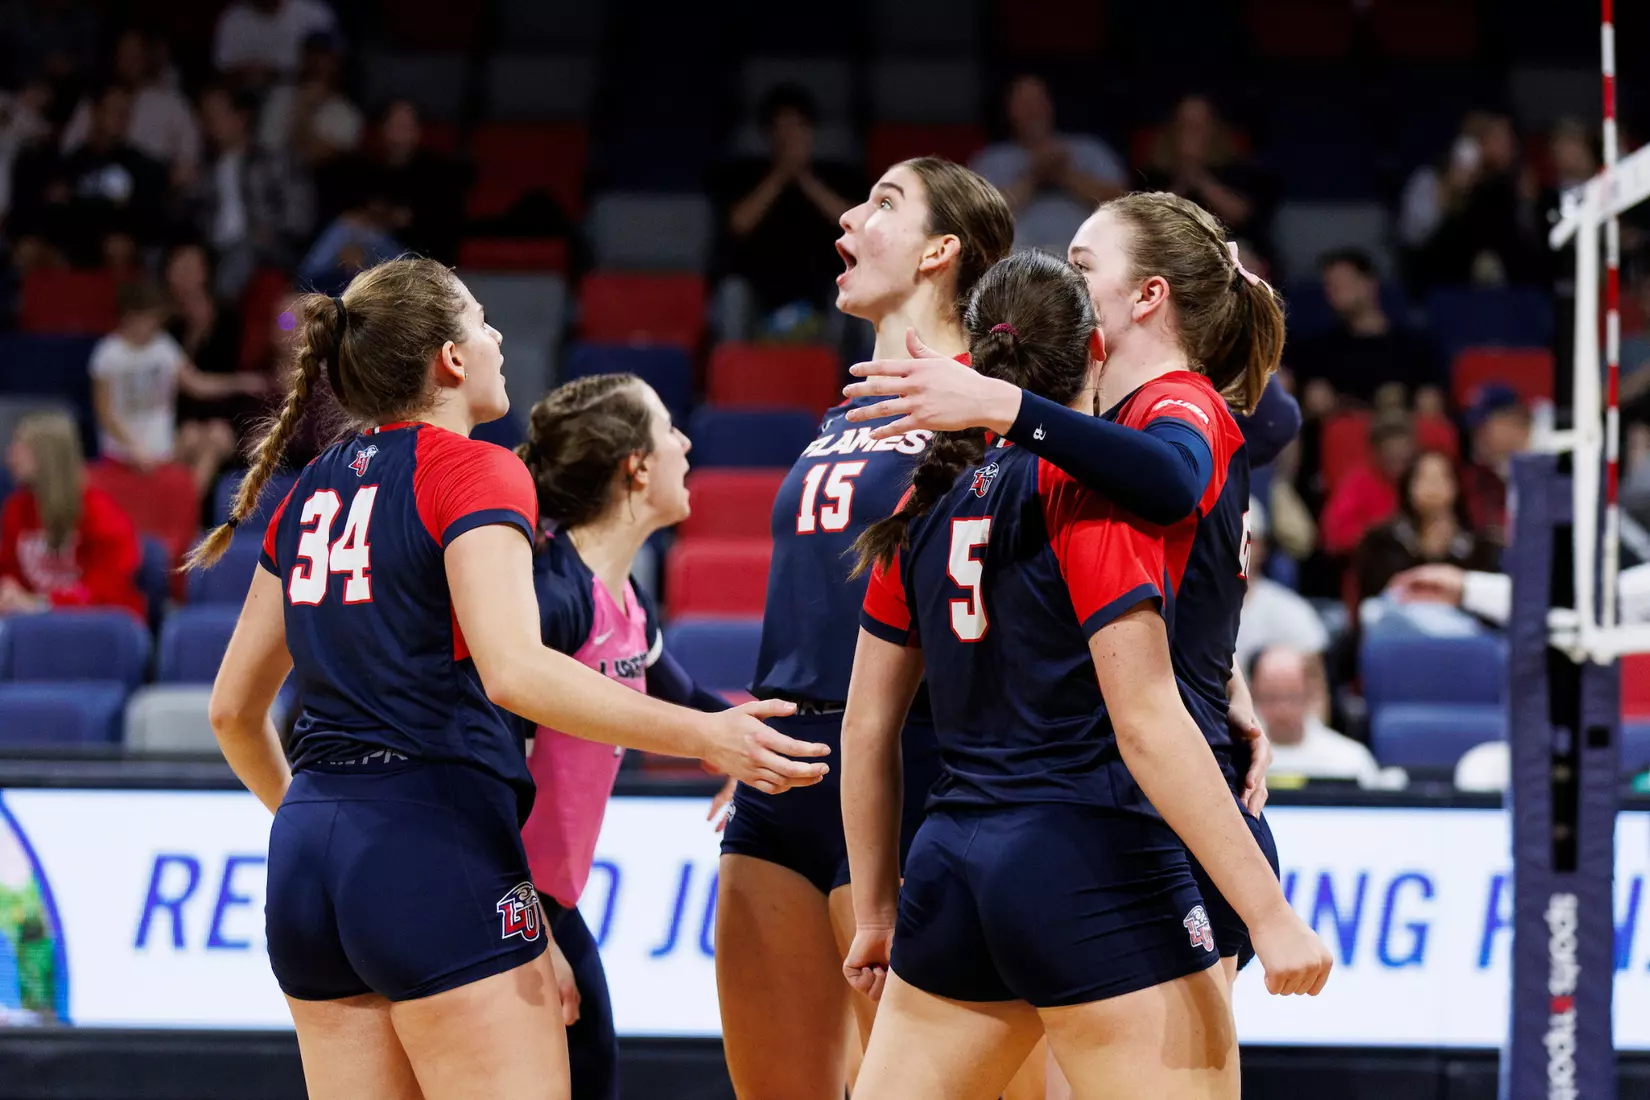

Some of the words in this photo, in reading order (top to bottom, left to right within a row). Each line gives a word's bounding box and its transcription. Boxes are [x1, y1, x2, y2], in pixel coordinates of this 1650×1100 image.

[796, 459, 868, 535] 15
[287, 484, 379, 607] 34
[946, 515, 992, 643] 5
[134, 854, 267, 949] RE
[496, 888, 541, 942] LU
